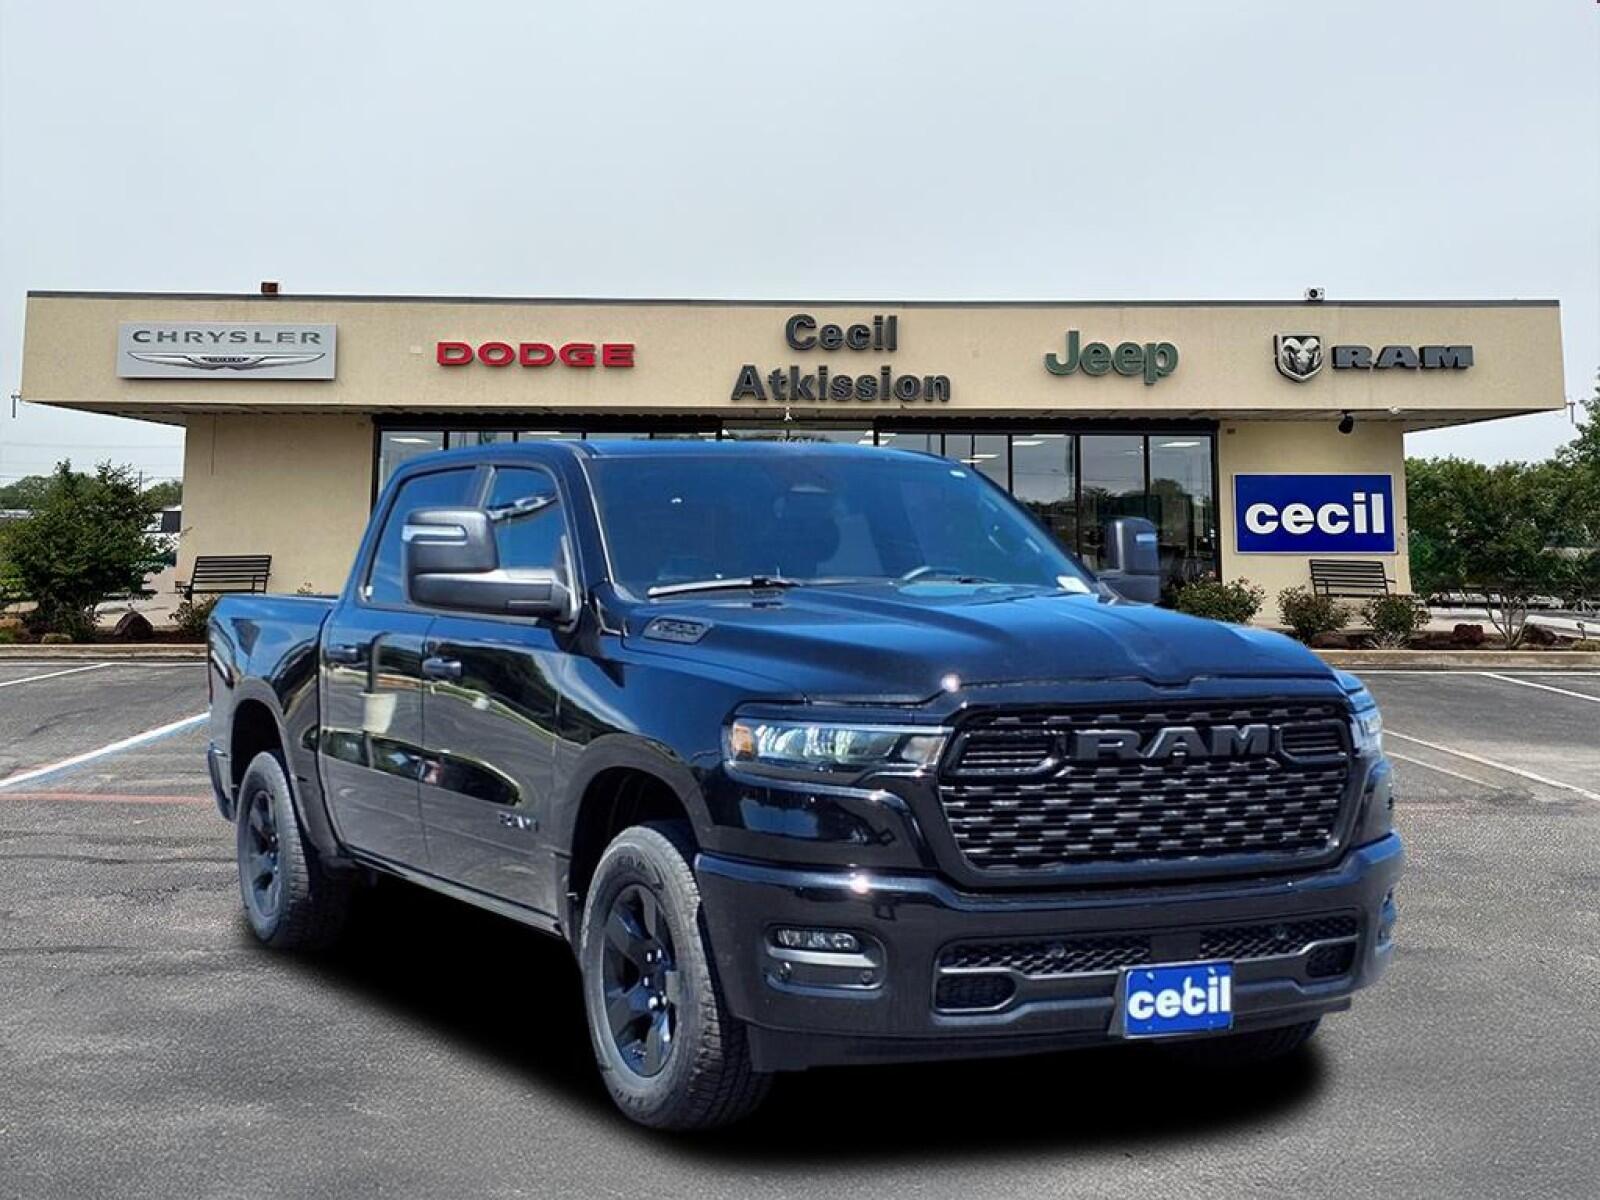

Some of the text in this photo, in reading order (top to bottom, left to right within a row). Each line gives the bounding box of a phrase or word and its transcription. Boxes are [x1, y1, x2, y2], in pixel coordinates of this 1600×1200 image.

[132, 330, 321, 345] CHRYSLER
[785, 314, 898, 352] Cecil
[436, 341, 635, 368] DODGE
[1045, 330, 1179, 386] Jeep
[1331, 345, 1474, 370] RAM
[731, 364, 951, 402] Atkission
[1245, 491, 1386, 535] cecil
[1073, 723, 1271, 760] RAM
